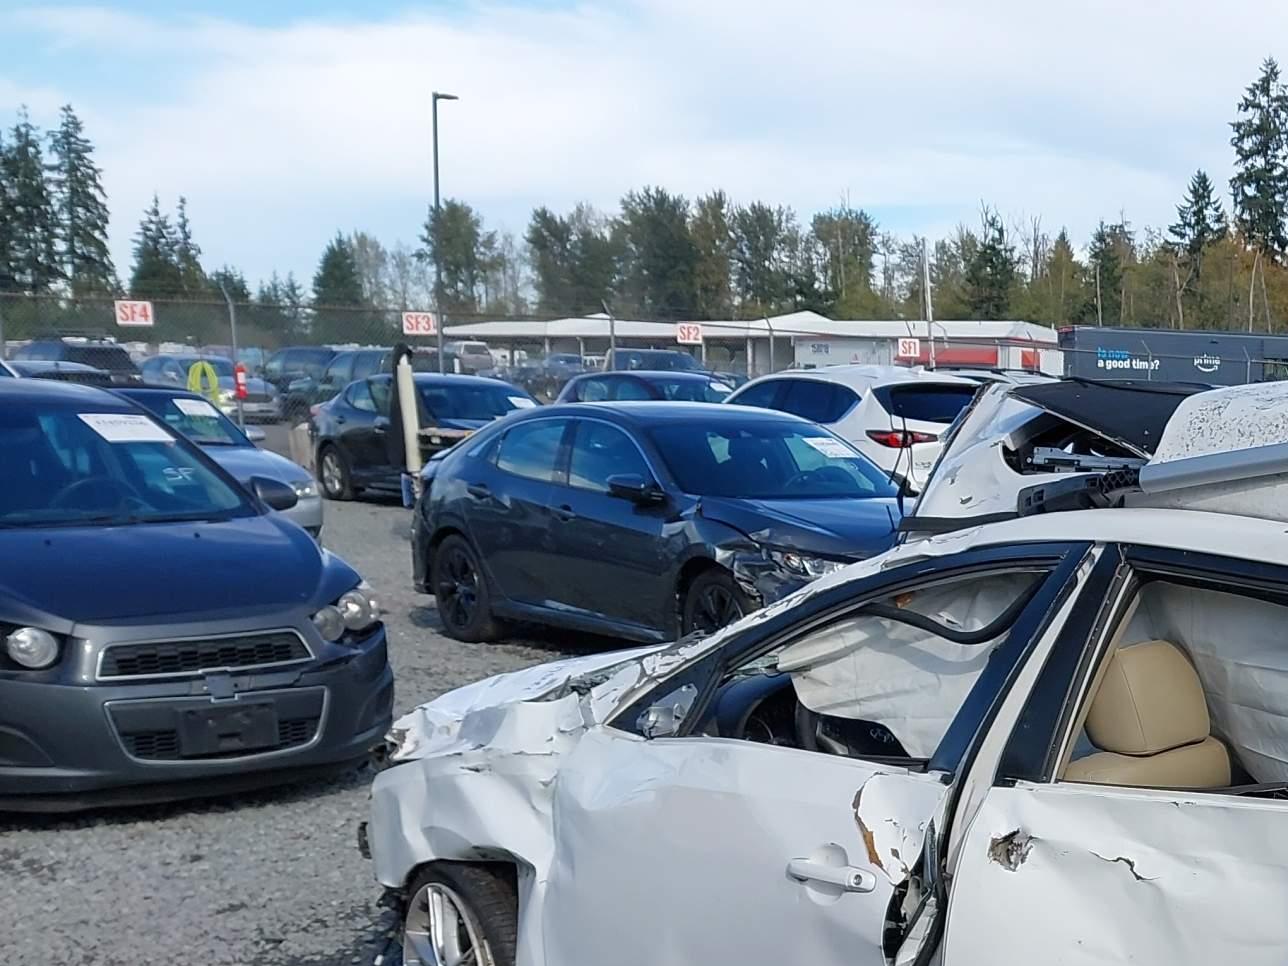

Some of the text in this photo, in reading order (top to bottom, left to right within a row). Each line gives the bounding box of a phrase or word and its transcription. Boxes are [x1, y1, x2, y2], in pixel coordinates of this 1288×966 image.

[118, 303, 149, 321] SF4
[405, 314, 431, 331] SF3
[680, 325, 700, 341] SF2
[901, 340, 918, 355] SF1
[1097, 359, 1104, 368] a
[1105, 358, 1131, 370] good
